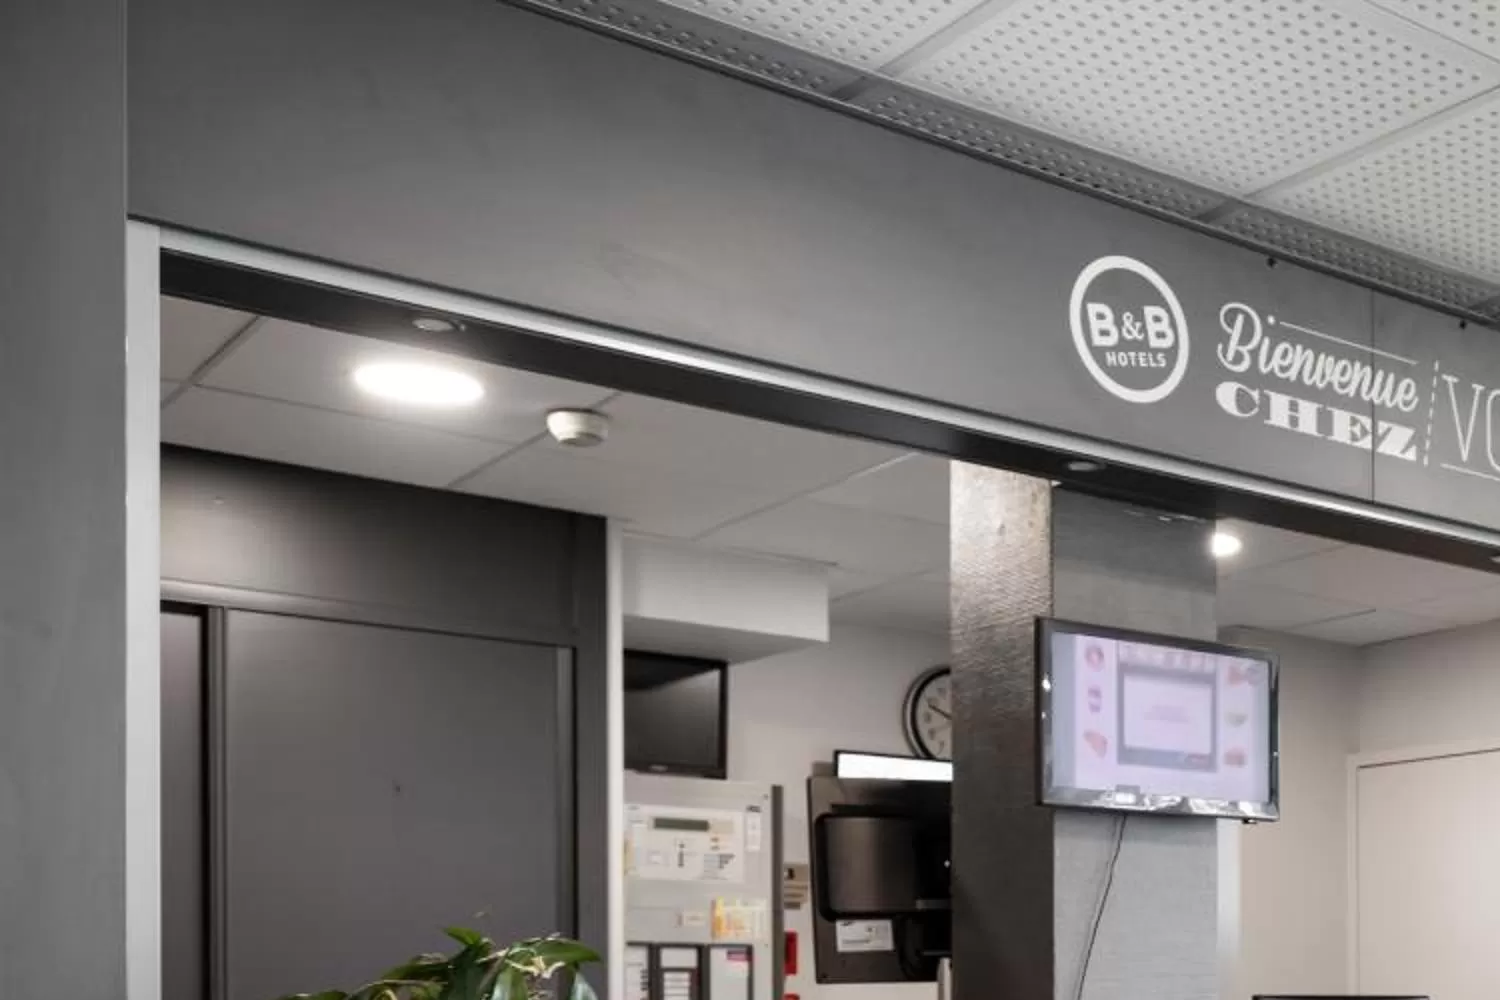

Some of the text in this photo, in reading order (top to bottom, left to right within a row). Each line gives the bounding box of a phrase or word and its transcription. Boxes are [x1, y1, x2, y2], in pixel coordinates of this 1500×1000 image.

[1086, 302, 1176, 349] B&B
[1216, 301, 1420, 412] Bienvenue
[1105, 351, 1167, 368] HOTELS
[1215, 380, 1418, 462] CHEZ
